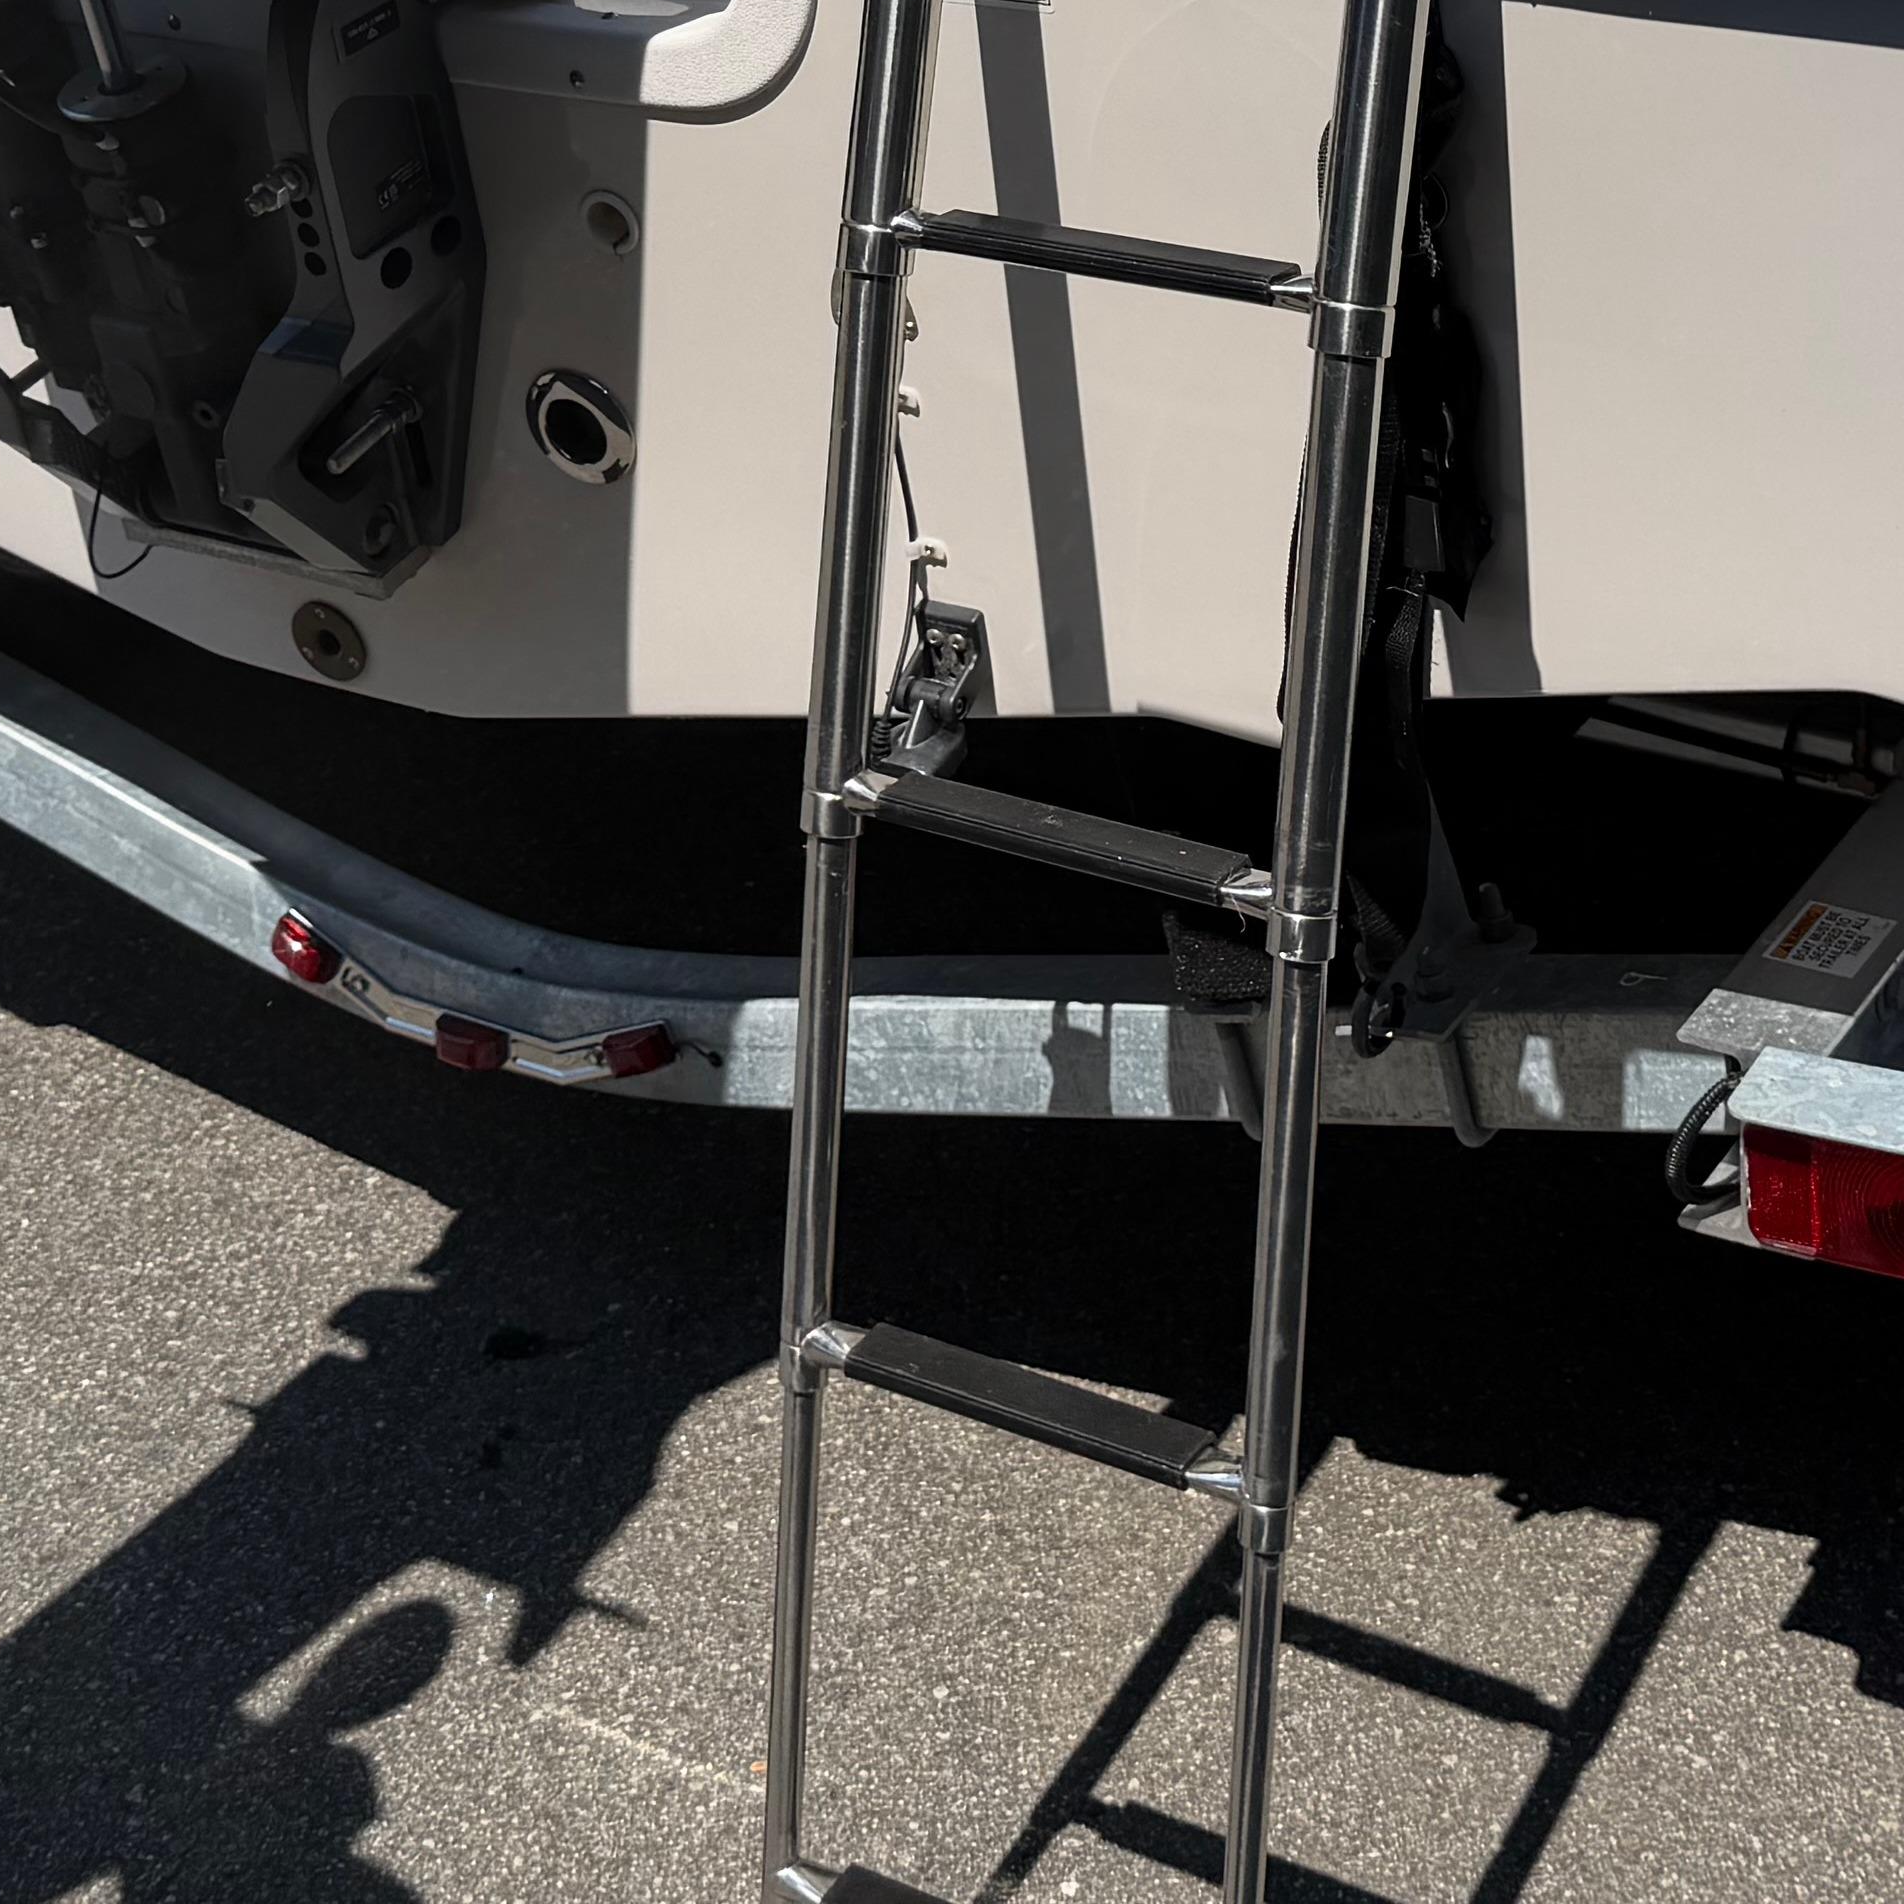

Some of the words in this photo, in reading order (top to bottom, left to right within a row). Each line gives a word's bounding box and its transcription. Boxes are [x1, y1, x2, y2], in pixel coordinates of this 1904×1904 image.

[1836, 917, 1852, 927] TO
[1792, 941, 1812, 960] BOAT
[1818, 939, 1847, 968] TRAILER
[1853, 918, 1870, 929] ALL
[1845, 935, 1871, 955] TIMES
